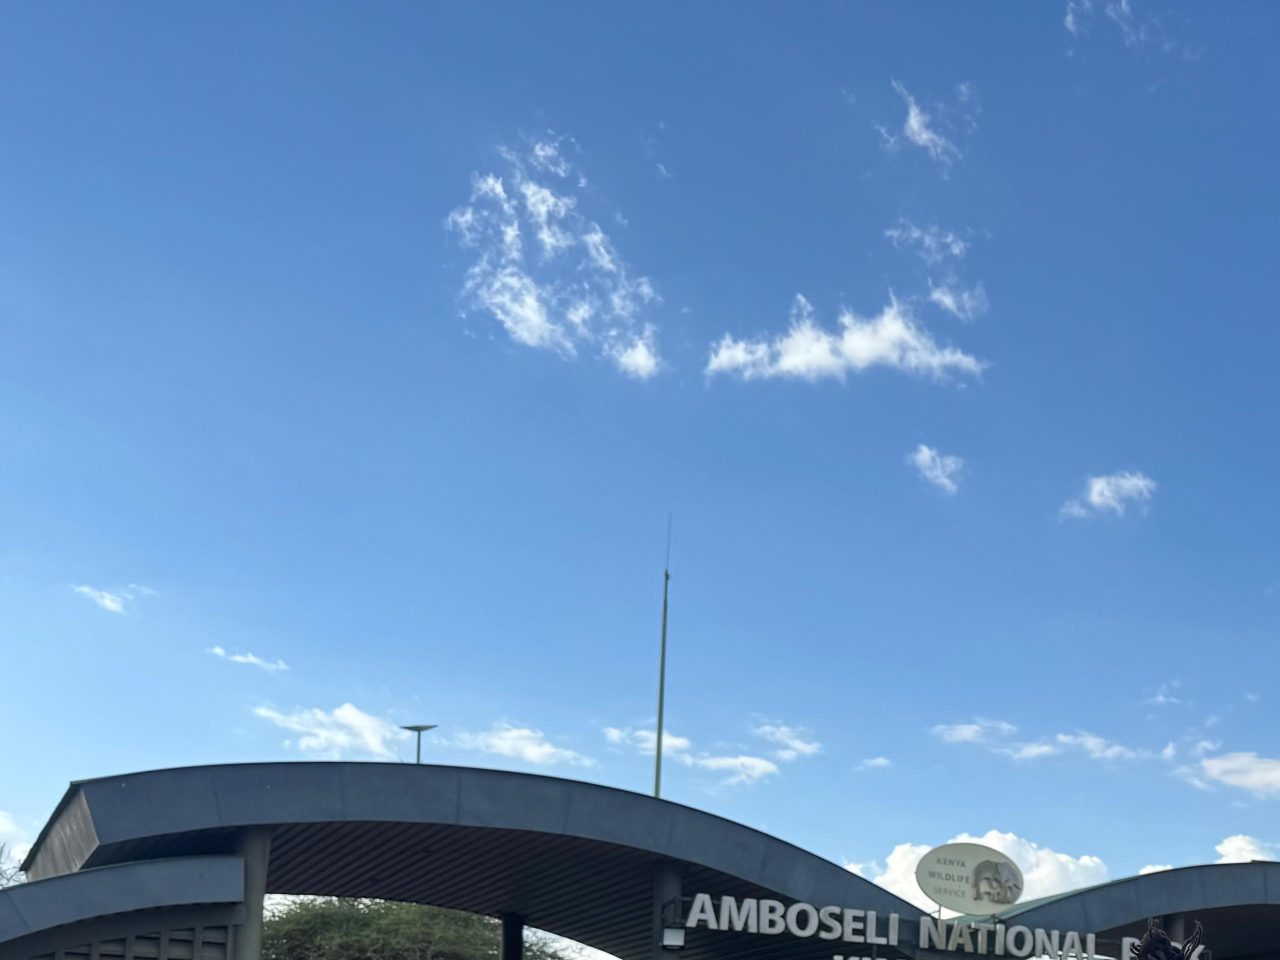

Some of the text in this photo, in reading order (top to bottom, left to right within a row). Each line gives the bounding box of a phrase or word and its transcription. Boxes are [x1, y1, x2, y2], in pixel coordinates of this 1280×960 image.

[937, 856, 966, 868] KENYA
[928, 871, 970, 884] WILDLIFE
[933, 887, 966, 898] SERVICE
[686, 892, 899, 946] AMBOSELI
